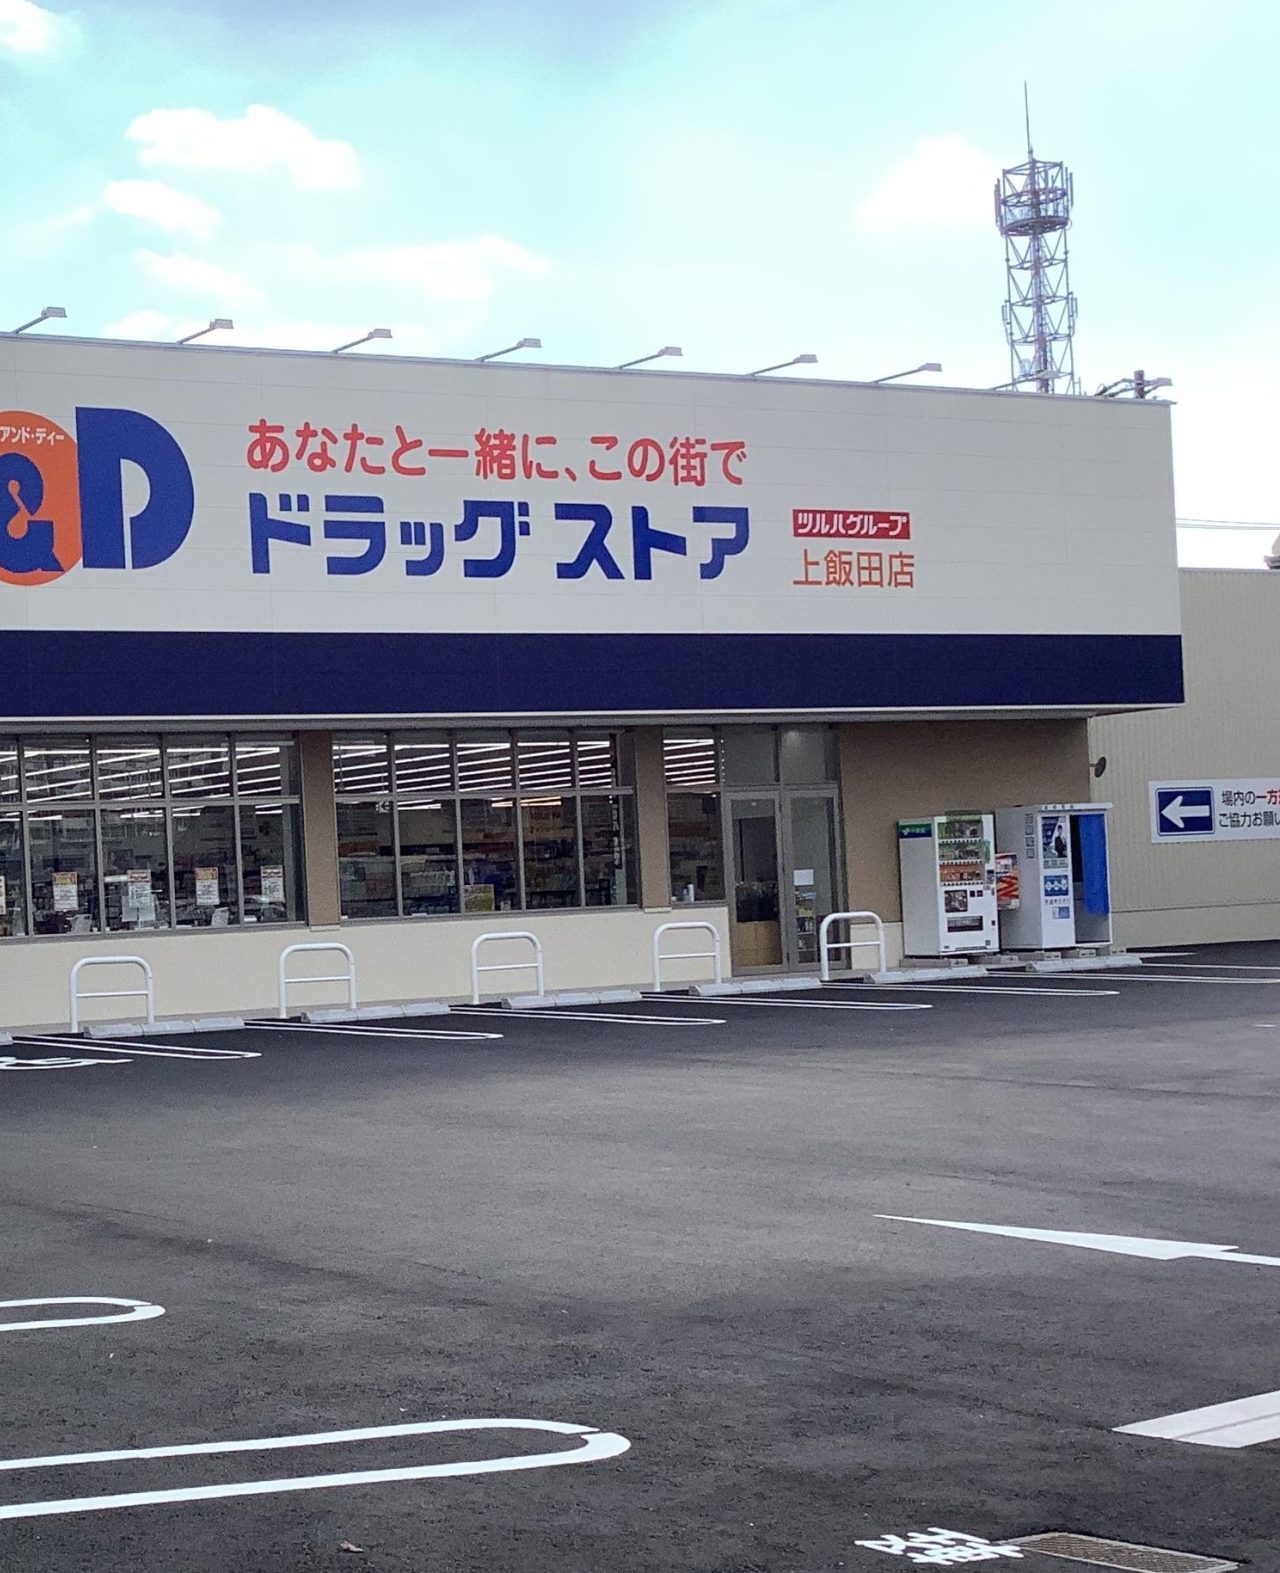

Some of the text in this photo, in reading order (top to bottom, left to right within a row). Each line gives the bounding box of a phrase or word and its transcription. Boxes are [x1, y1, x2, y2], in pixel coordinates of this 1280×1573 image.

[246, 417, 747, 486] あなたと一緒に、この街で
[248, 492, 750, 581] ドラッグストア
[797, 512, 908, 536] ツルハグループ
[793, 548, 915, 588] 上飯田店
[1221, 789, 1280, 807] 場内の一方
